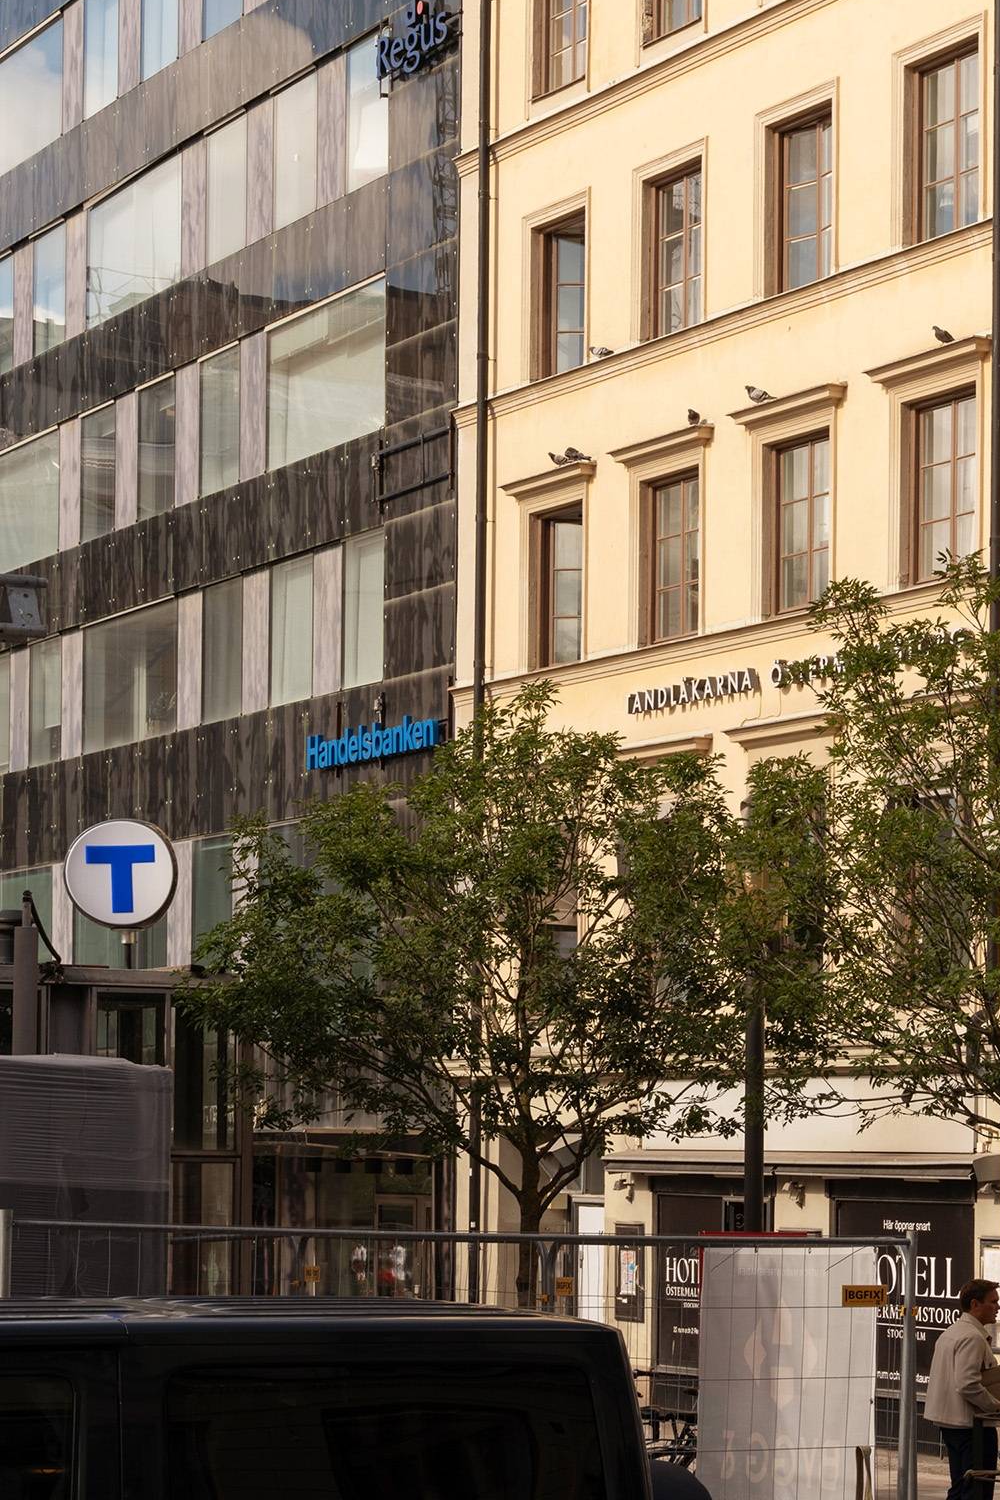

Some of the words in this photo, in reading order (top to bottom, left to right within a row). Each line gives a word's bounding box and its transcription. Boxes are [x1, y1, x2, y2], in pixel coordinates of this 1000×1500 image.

[377, 11, 449, 79] Regus
[306, 716, 438, 771] Handelsbanken
[85, 844, 155, 913] T
[666, 1257, 700, 1284] HOT
[848, 1290, 880, 1299] BGFIX
[877, 1254, 961, 1299] OTELL
